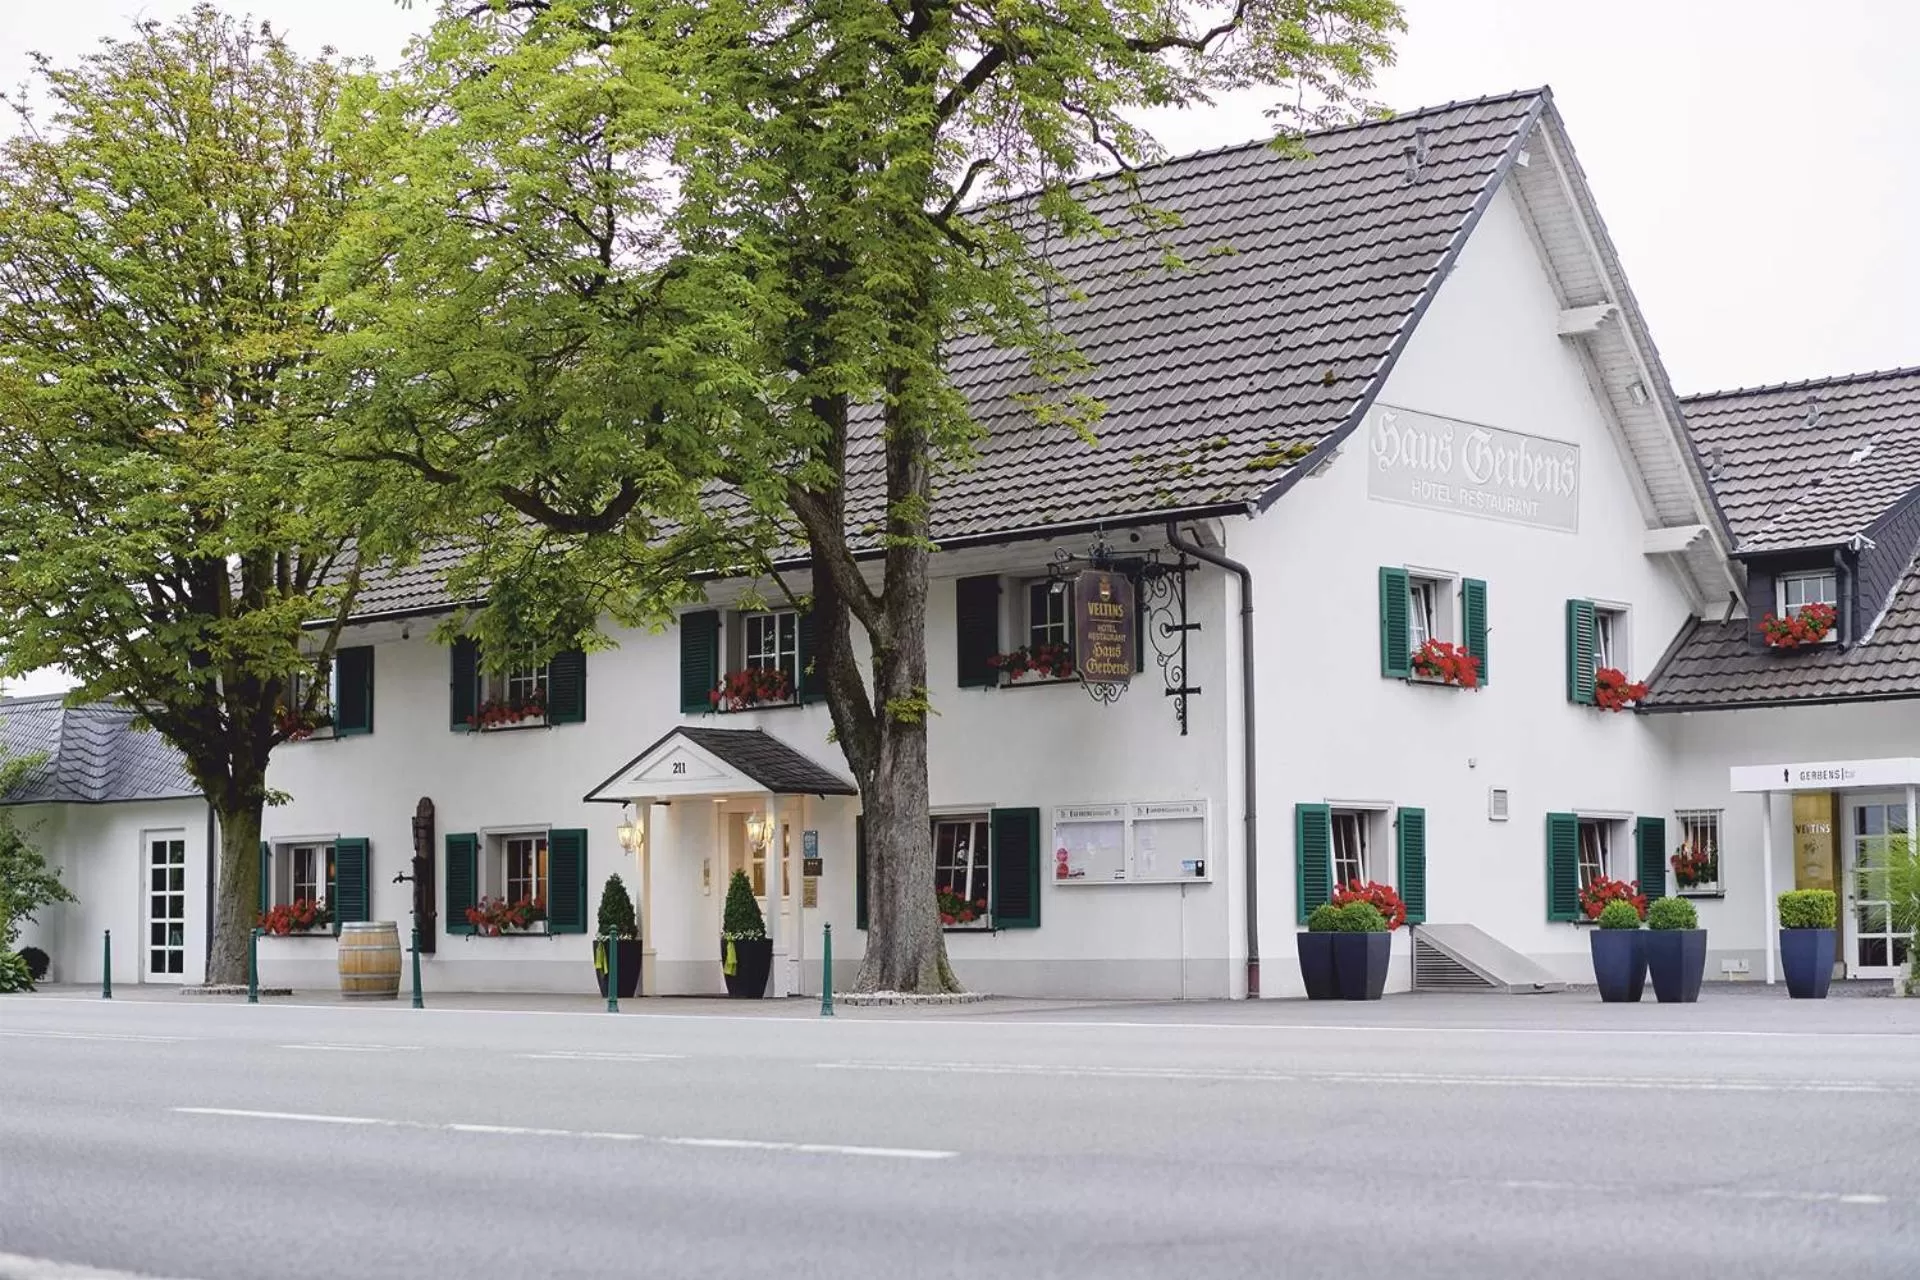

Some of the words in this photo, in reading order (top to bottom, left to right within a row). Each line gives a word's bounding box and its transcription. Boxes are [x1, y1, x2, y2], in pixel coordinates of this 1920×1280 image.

[1371, 411, 1454, 472] Haus
[1464, 428, 1576, 497] Gerbens
[1412, 480, 1453, 503] HOTEL
[1460, 489, 1539, 516] RESTAURANT
[1088, 602, 1124, 617] VELTINS
[1093, 643, 1121, 658] Haus
[1086, 659, 1129, 674] Gerbens
[673, 762, 685, 773] 211
